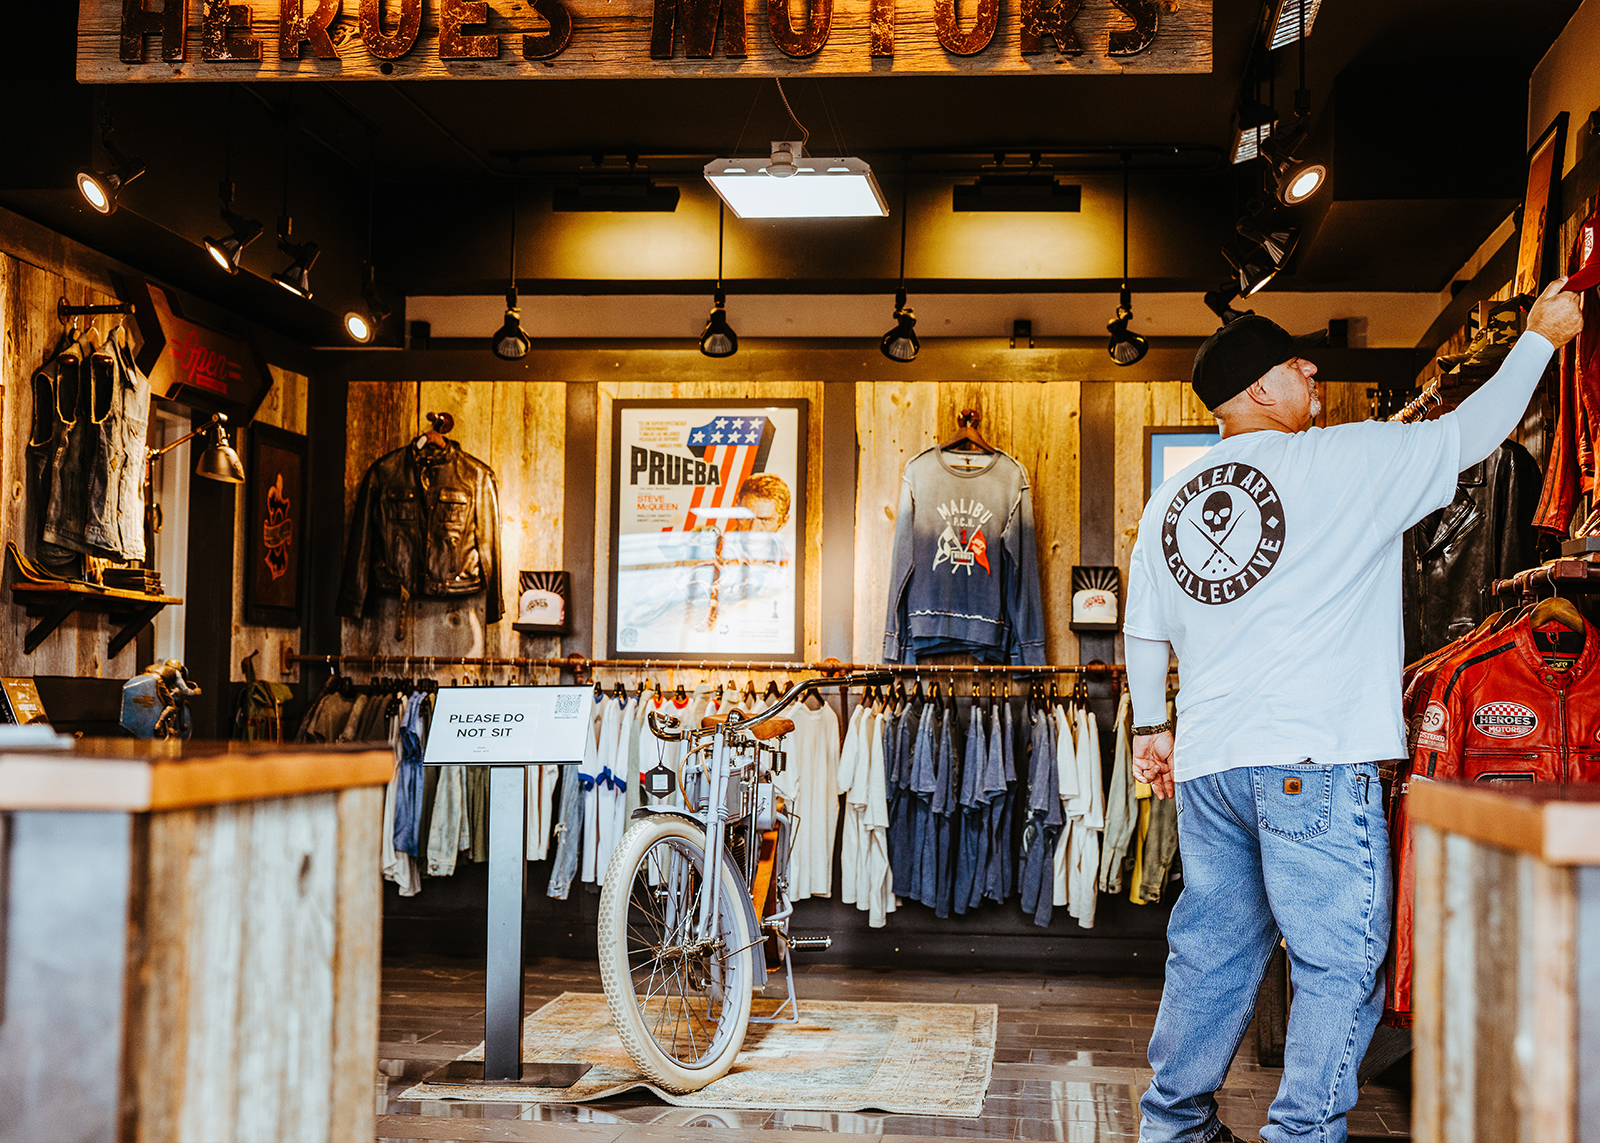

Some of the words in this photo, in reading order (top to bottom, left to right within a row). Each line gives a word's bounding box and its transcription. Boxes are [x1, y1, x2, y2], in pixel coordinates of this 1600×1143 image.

[119, 0, 574, 63] HEROES
[181, 331, 228, 381] Open
[630, 445, 720, 485] PRUEBA
[637, 494, 665, 503] STEVE
[1166, 465, 1237, 525] SULLEN
[1239, 470, 1277, 507] ART
[637, 503, 678, 511] McQUEEN
[936, 498, 993, 524] MALIBU
[960, 528, 968, 545] 1
[1168, 538, 1281, 603] COLLECTIVE
[449, 714, 500, 723] PLEASE
[503, 713, 525, 723] DO
[1424, 711, 1441, 726] 55
[1480, 715, 1531, 725] HEROES
[456, 728, 486, 737] NOT
[491, 728, 513, 737] SIT
